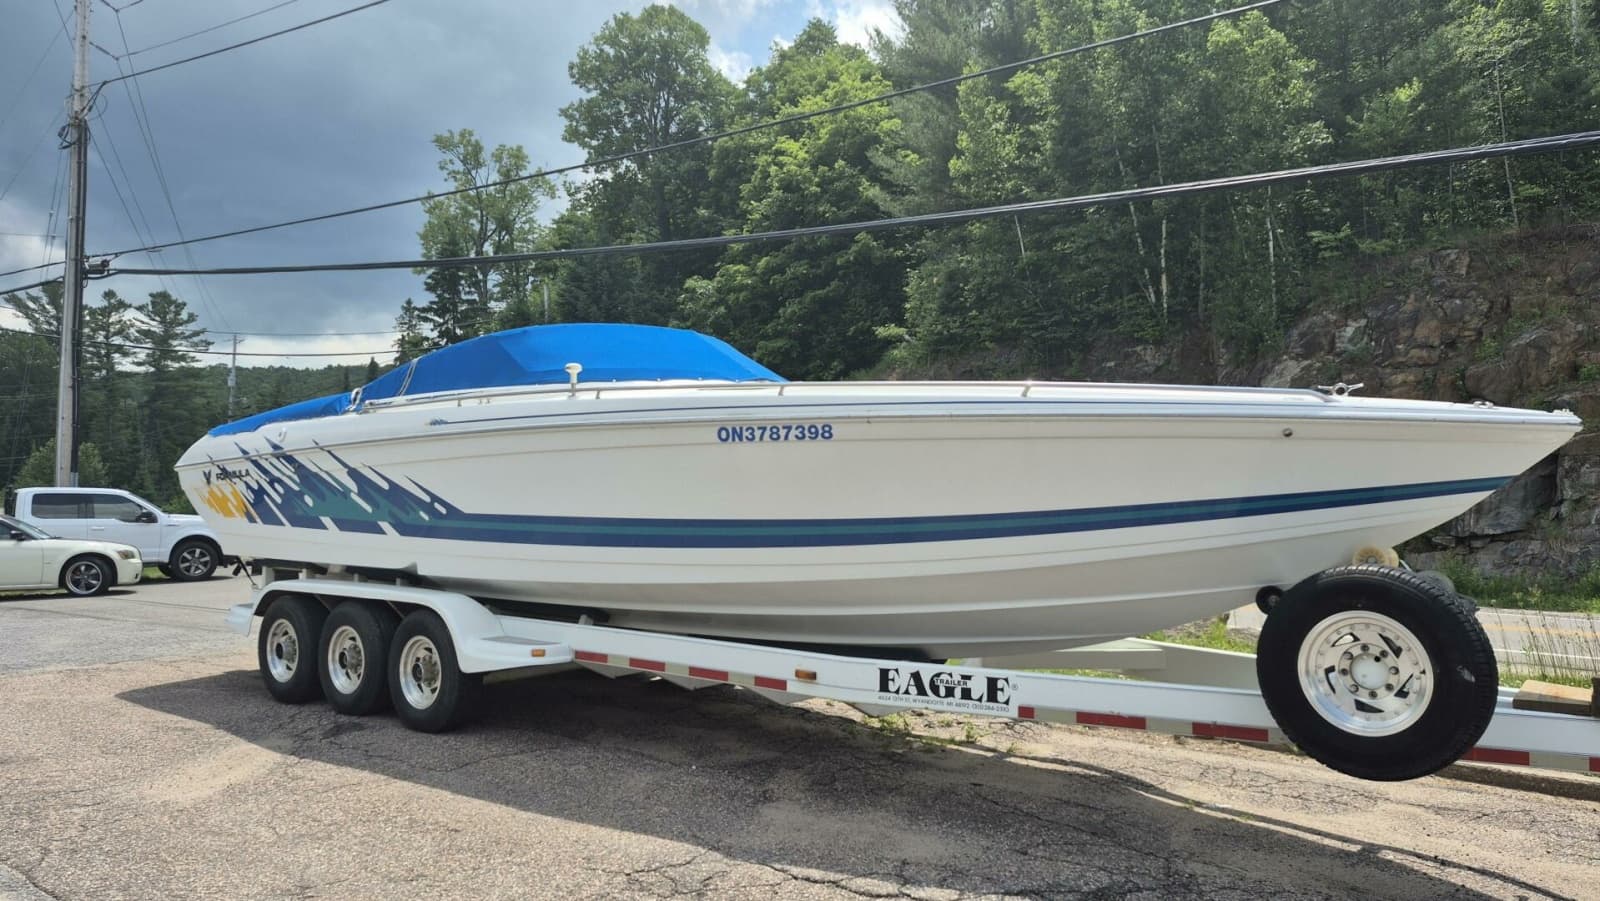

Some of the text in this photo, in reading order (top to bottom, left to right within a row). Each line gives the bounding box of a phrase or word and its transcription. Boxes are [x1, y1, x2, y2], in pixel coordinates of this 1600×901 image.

[717, 424, 833, 442] ON3787398
[878, 667, 1011, 706] EAGLE
[934, 678, 968, 687] TRAILER
